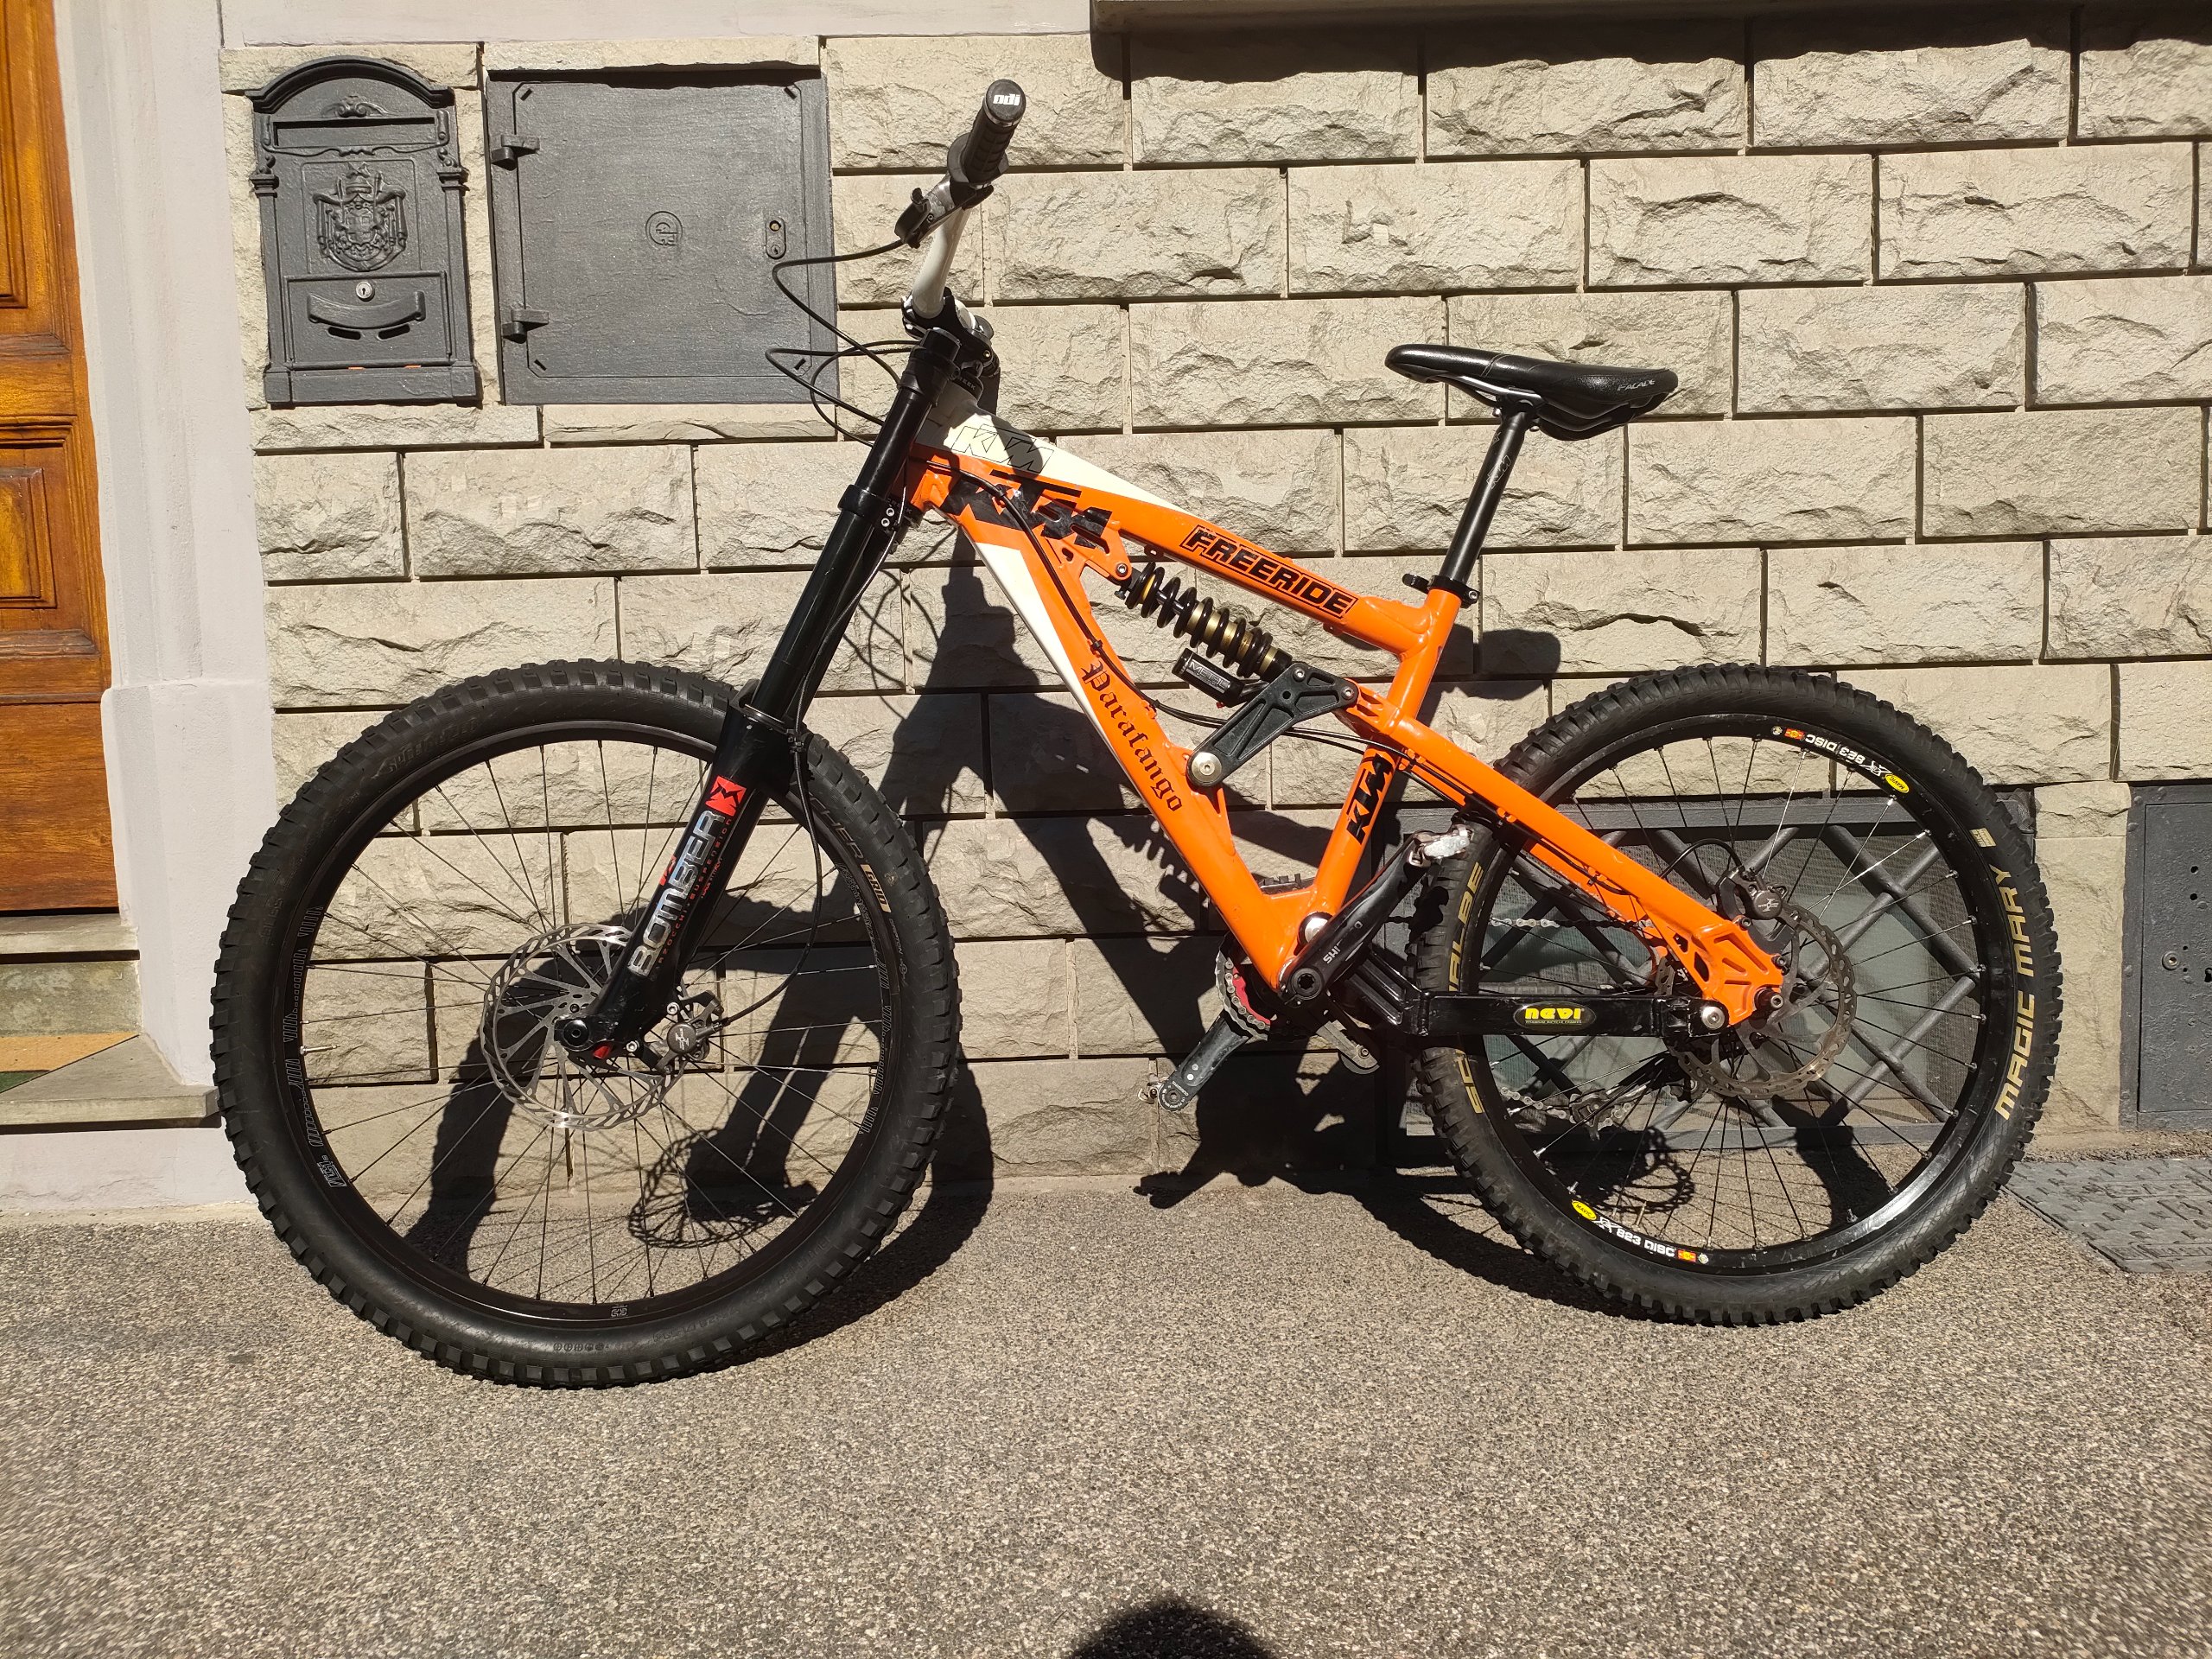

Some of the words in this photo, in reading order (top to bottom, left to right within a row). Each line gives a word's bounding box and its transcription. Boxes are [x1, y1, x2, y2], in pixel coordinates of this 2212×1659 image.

[993, 93, 1020, 105] odi
[1185, 527, 1356, 615] FREERIDE
[1082, 658, 1185, 813] Parafango
[1805, 734, 1837, 751] DISC
[1840, 747, 1866, 765] 823
[1347, 753, 1393, 843] KTM
[627, 810, 725, 976] BOMBER
[811, 796, 865, 860] CHER
[866, 869, 889, 908] GRID
[1994, 866, 2034, 979] MARY
[1448, 862, 1485, 1114] SCALBE
[1995, 995, 2036, 1122] MAGIC
[1576, 1204, 1593, 1217] MAVIC
[1617, 1229, 1642, 1245] 823
[1644, 1240, 1675, 1257] DISC
